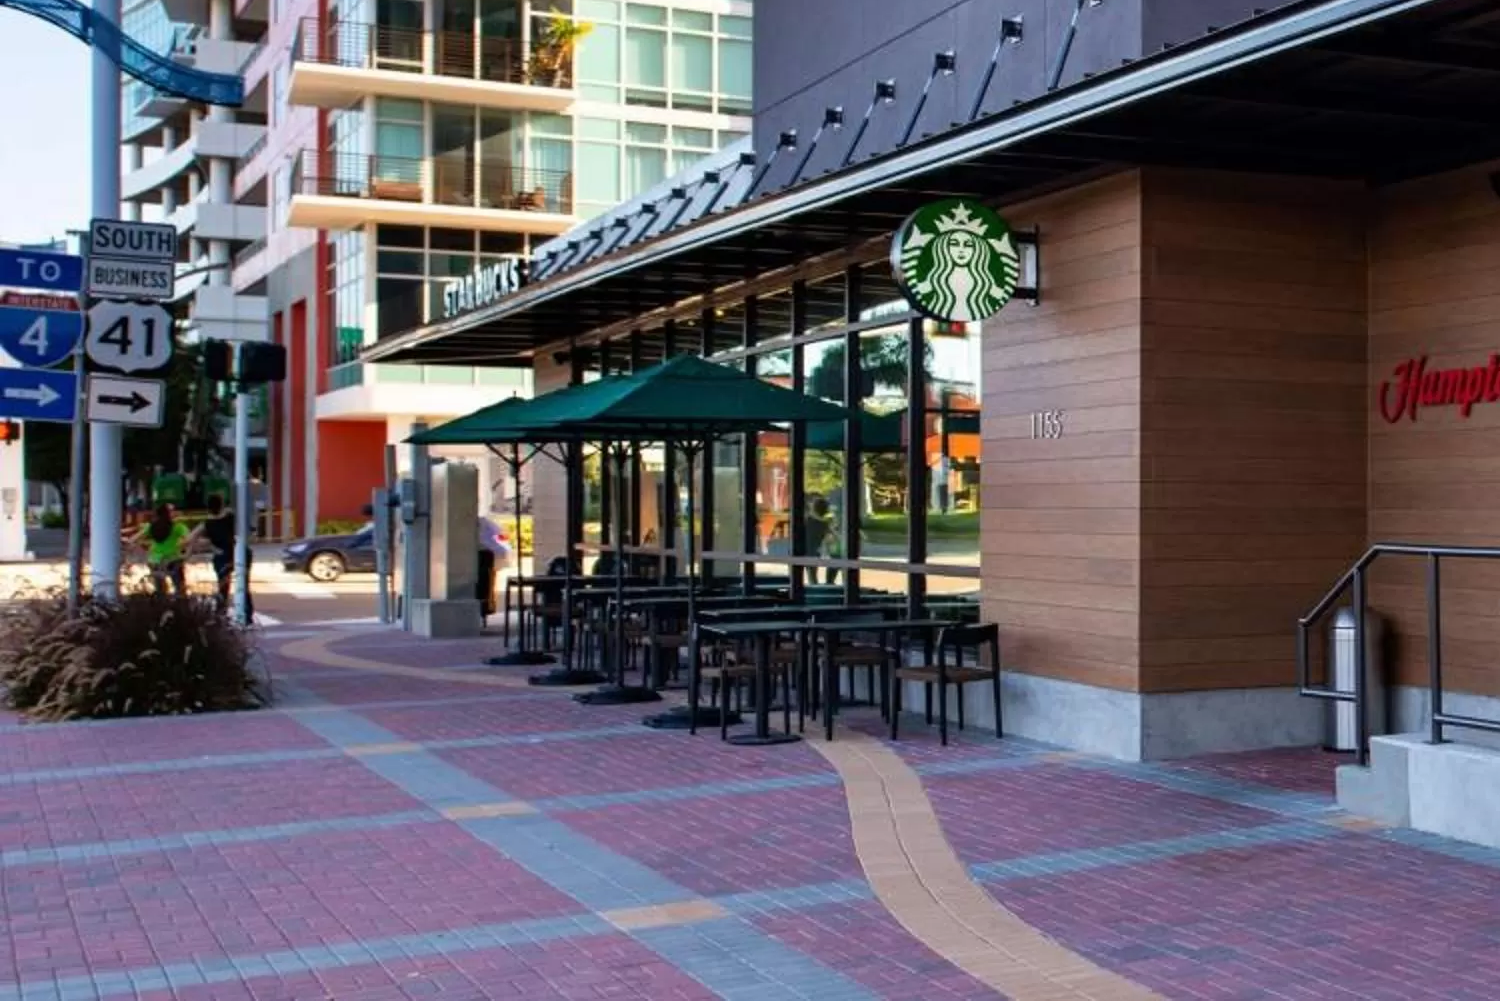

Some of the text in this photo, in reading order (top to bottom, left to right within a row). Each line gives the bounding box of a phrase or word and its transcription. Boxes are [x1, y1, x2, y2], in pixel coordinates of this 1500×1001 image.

[95, 225, 172, 253] SOUTH
[16, 257, 62, 282] TO
[95, 266, 168, 289] BUSINESS
[444, 256, 519, 318] STARBUCKS
[19, 315, 49, 357] 4
[97, 315, 156, 358] 41
